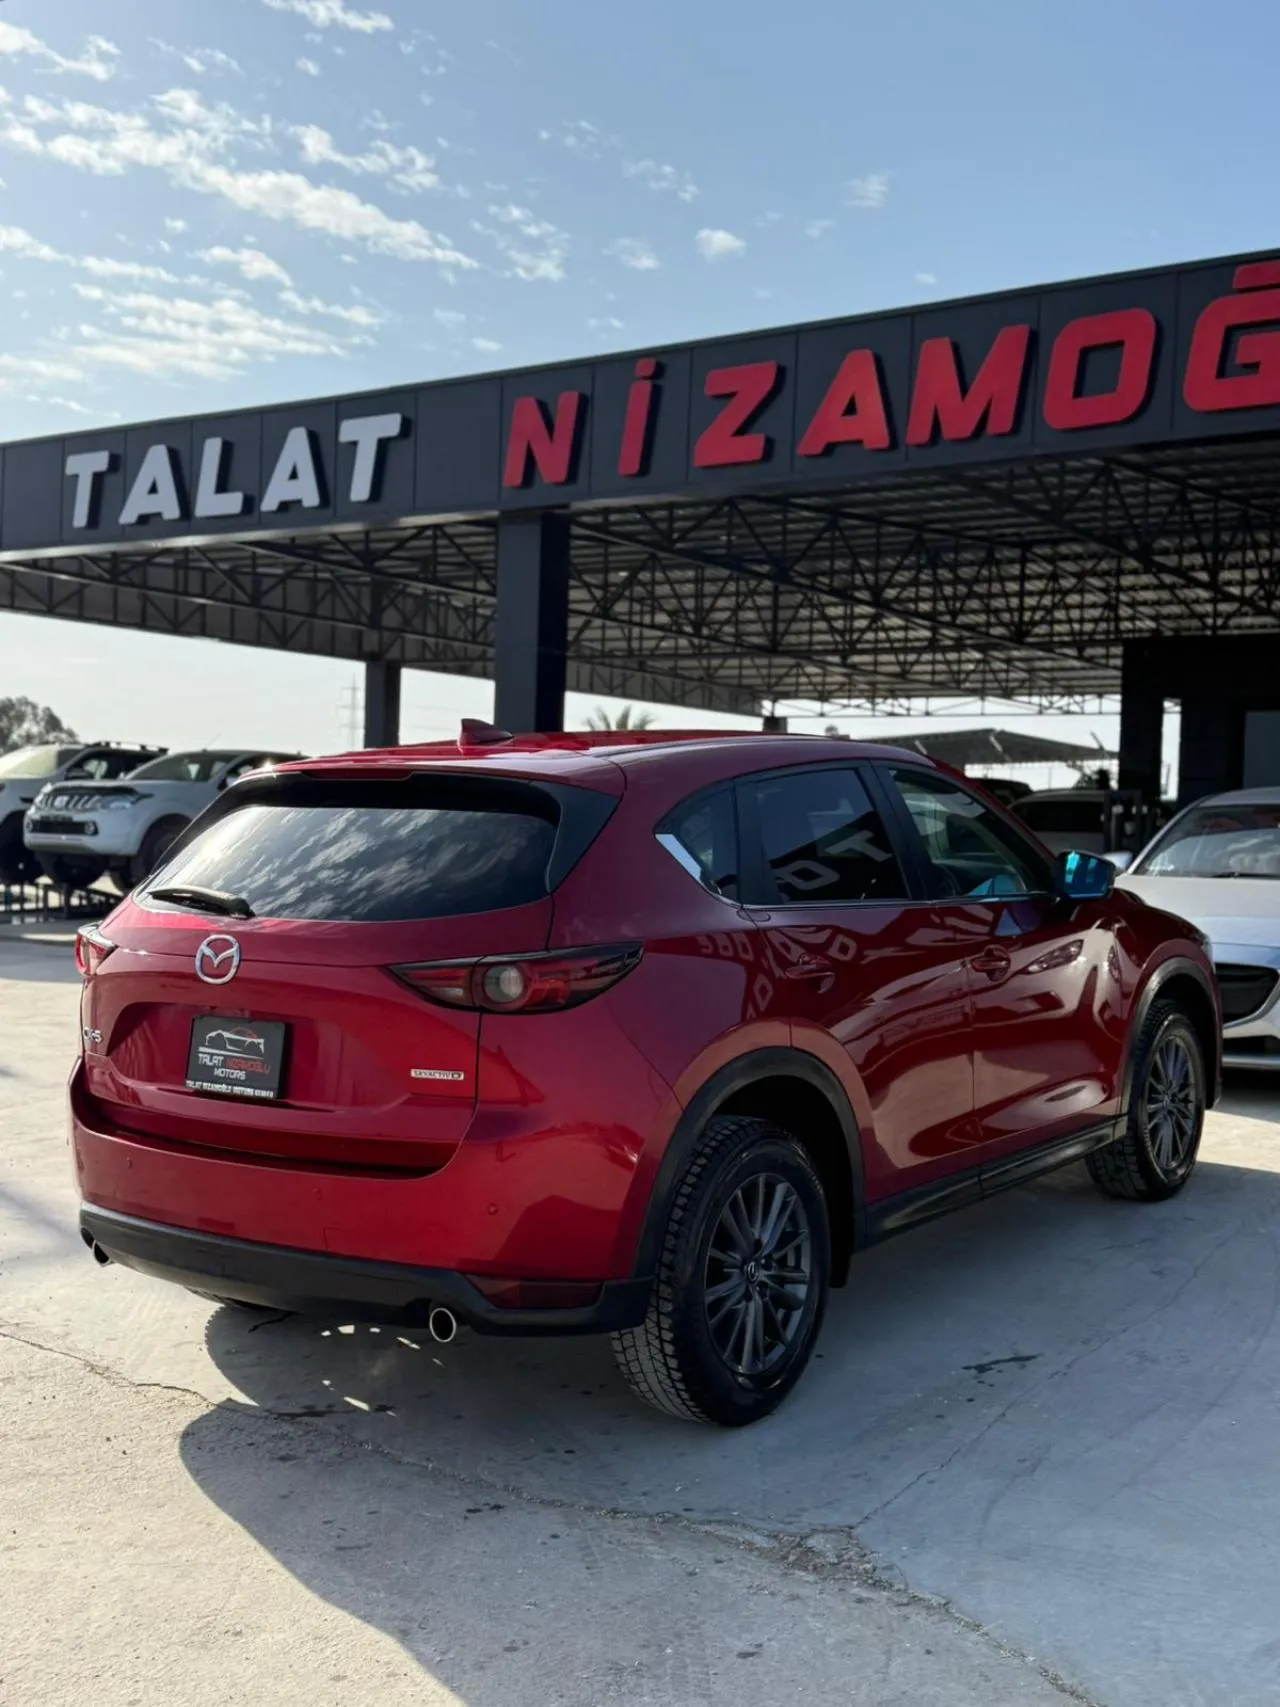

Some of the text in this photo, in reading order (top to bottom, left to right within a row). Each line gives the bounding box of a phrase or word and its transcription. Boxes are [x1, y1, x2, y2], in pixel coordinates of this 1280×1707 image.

[65, 412, 403, 529] TALAT
[198, 1053, 224, 1066] TALAT
[214, 1067, 246, 1080] MOTORS
